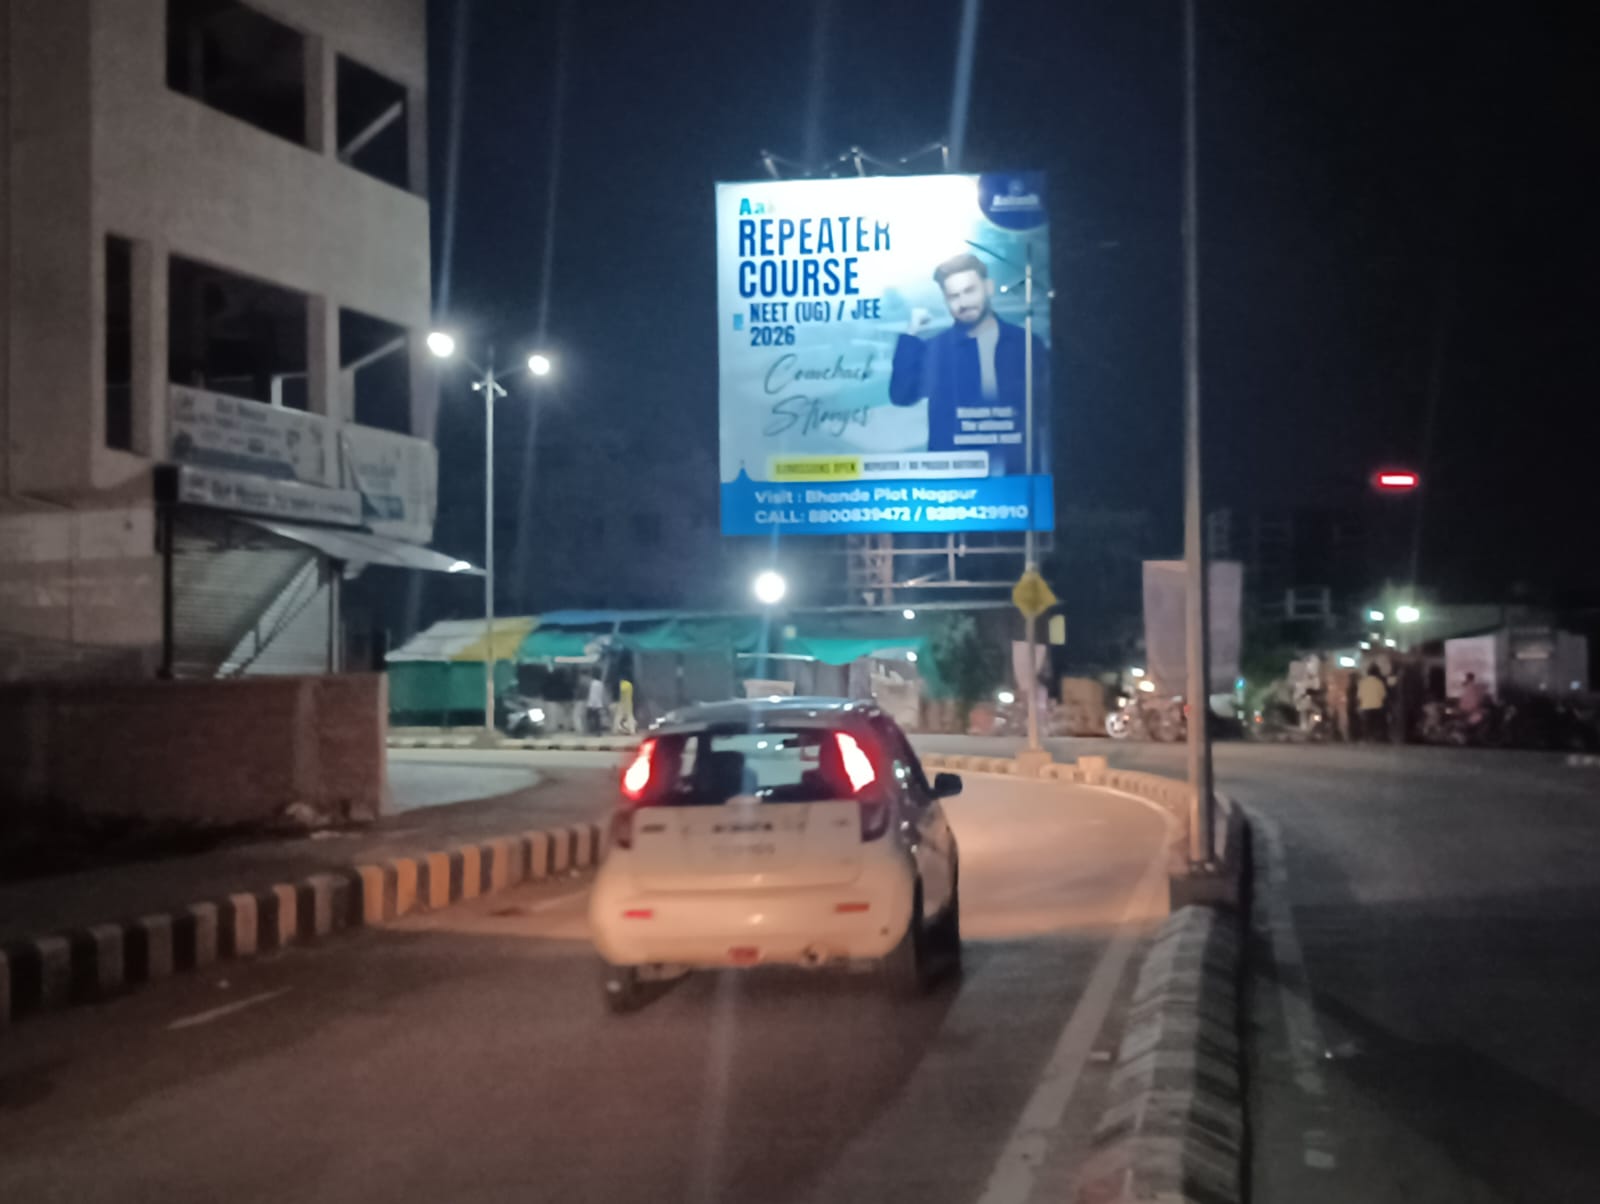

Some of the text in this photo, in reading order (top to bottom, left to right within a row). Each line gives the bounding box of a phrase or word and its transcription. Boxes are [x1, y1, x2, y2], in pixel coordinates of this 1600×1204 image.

[739, 216, 890, 257] REPEATER
[738, 257, 860, 298] COURSE
[750, 298, 881, 325] NEET (UG) / JEE
[750, 325, 796, 347] 2026
[763, 353, 875, 394] Comeback
[755, 491, 793, 505] Visit
[805, 490, 870, 504] Bhande
[874, 488, 908, 502] Plot
[912, 488, 977, 503] Nagpur
[755, 510, 804, 525] CALL:
[914, 506, 922, 522] /
